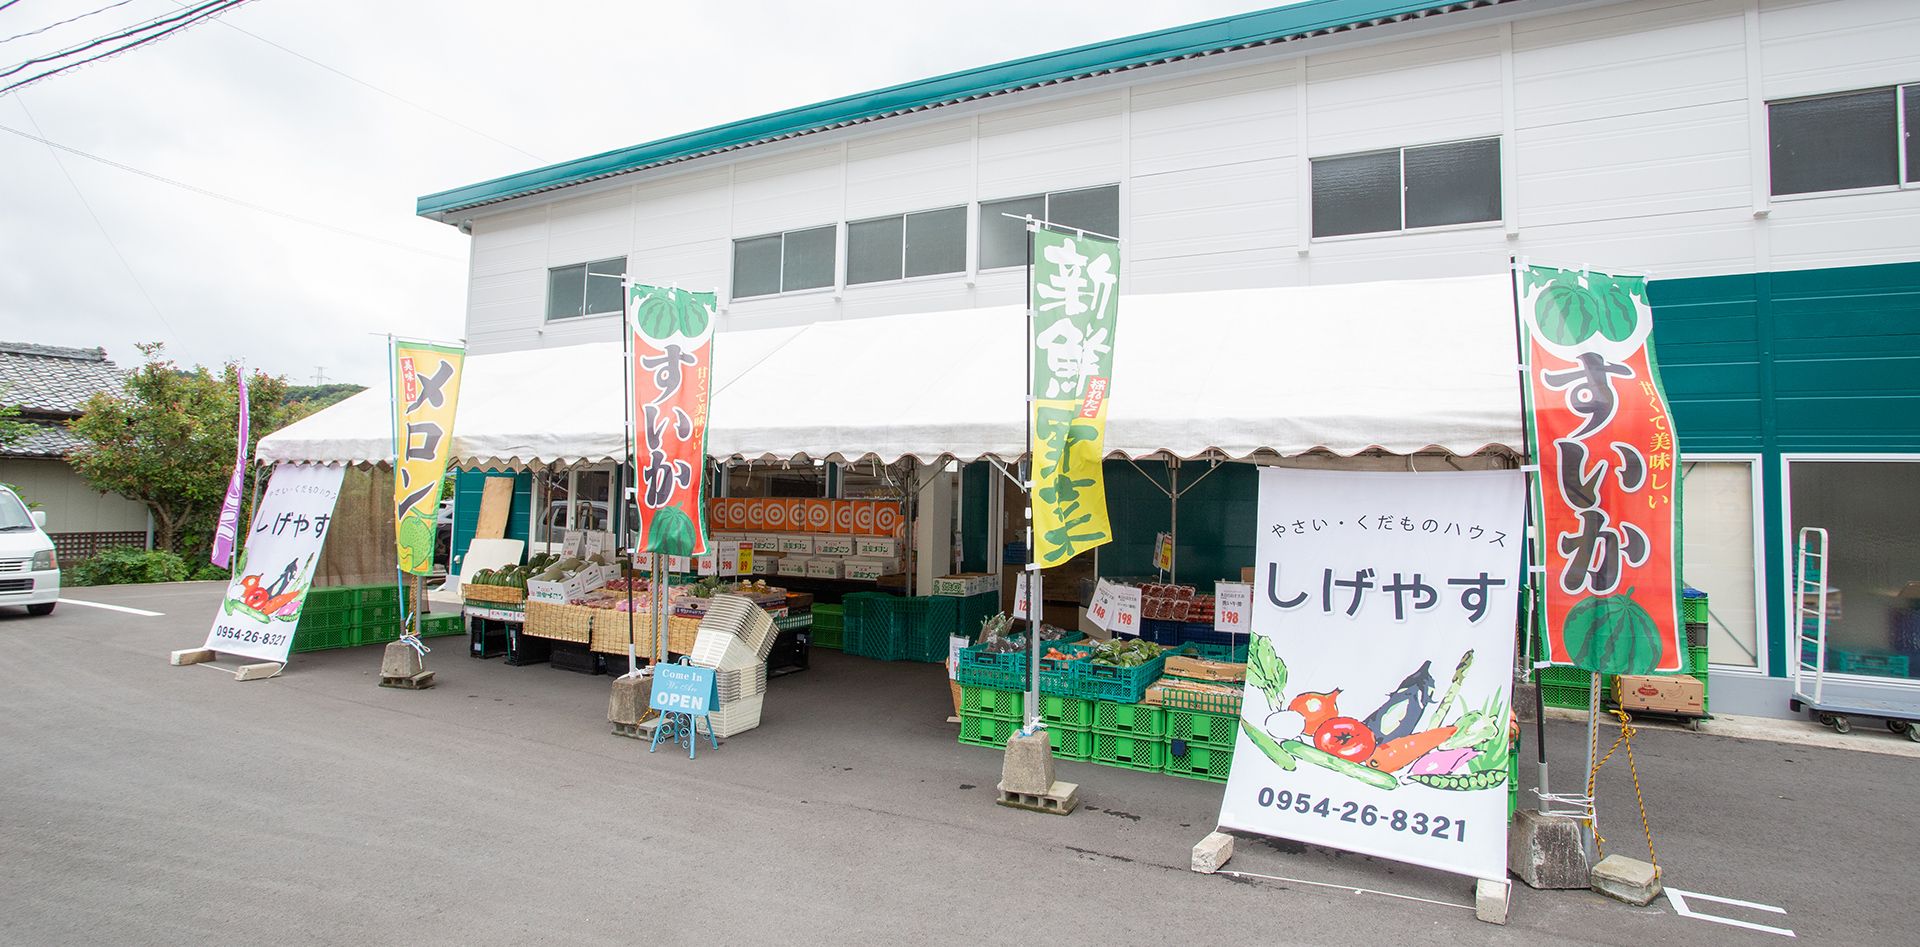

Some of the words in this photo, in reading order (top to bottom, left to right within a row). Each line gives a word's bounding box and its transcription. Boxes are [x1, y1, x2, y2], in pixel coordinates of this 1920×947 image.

[403, 358, 415, 400] 美味しい
[1036, 238, 1117, 560] 新鮮野菜
[1081, 377, 1106, 418] 採れたて
[641, 344, 697, 508] すいか
[693, 366, 708, 450] 甘くて美味しい
[398, 360, 453, 520] メロン
[1639, 381, 1671, 509] 甘くて美味しい
[1543, 352, 1648, 593] すいか
[257, 510, 331, 538] しげやす
[1271, 515, 1507, 548] やさい・くだものハウス
[1093, 603, 1106, 619] 148
[1267, 561, 1507, 623] しげやす
[216, 625, 287, 646] 0954-26-8321
[1118, 612, 1132, 625] 198
[1221, 610, 1239, 624] 198
[662, 669, 689, 680] Come
[692, 672, 702, 682] In
[667, 680, 678, 690] We
[657, 691, 703, 710] OPEN
[1258, 787, 1466, 842] 0954-26-8321
